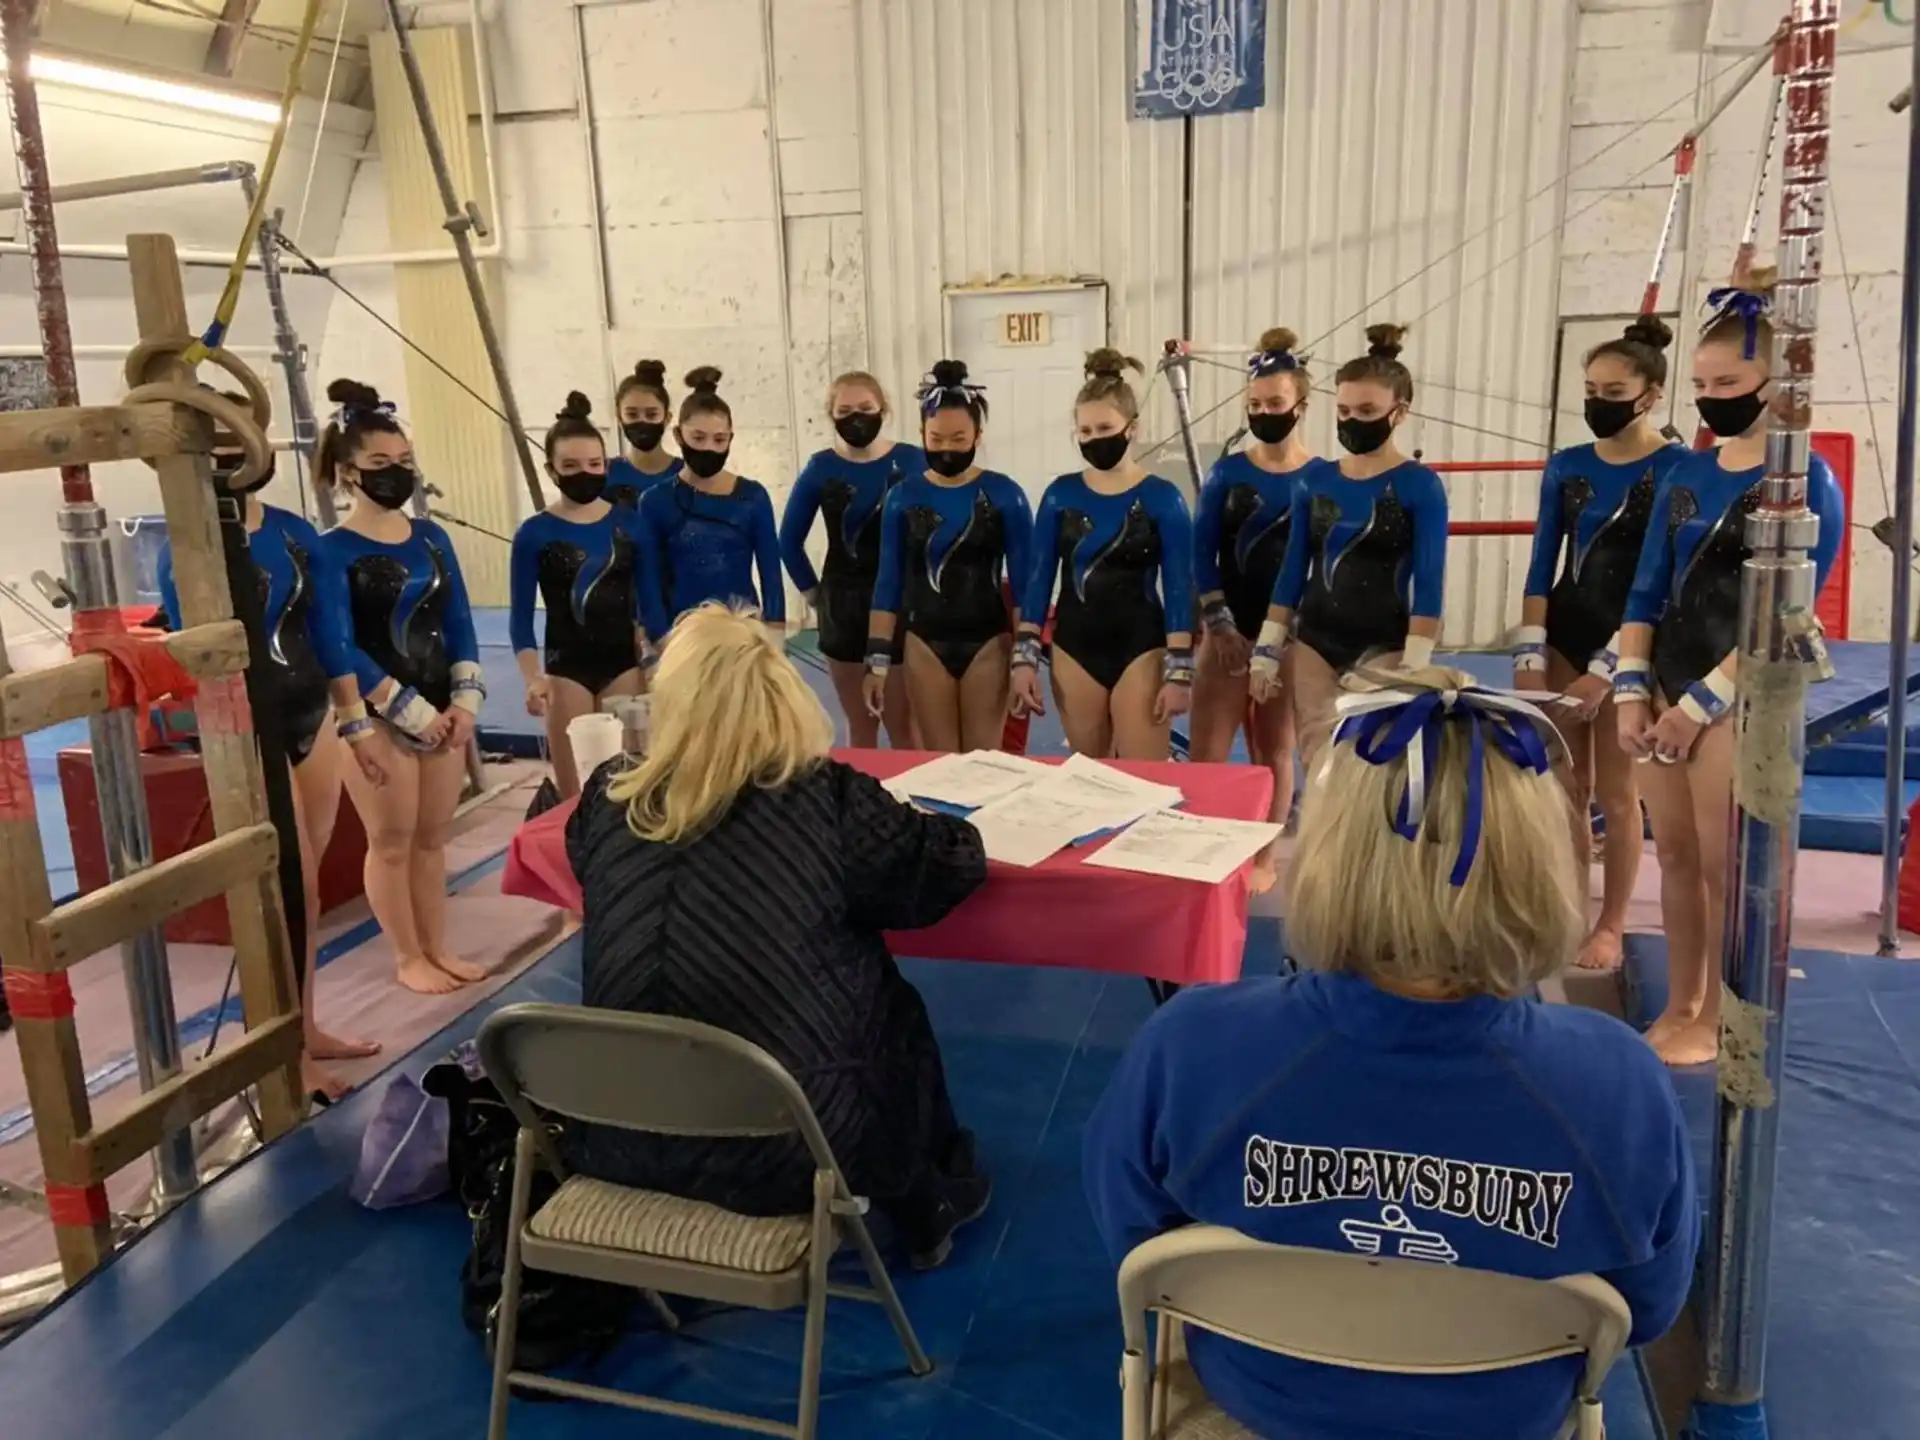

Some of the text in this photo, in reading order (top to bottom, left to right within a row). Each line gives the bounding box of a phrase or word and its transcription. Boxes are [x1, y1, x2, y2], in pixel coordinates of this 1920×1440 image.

[1160, 14, 1235, 51] USA
[1007, 312, 1043, 342] EXIT
[1244, 1134, 1572, 1248] SHREWSBURY
